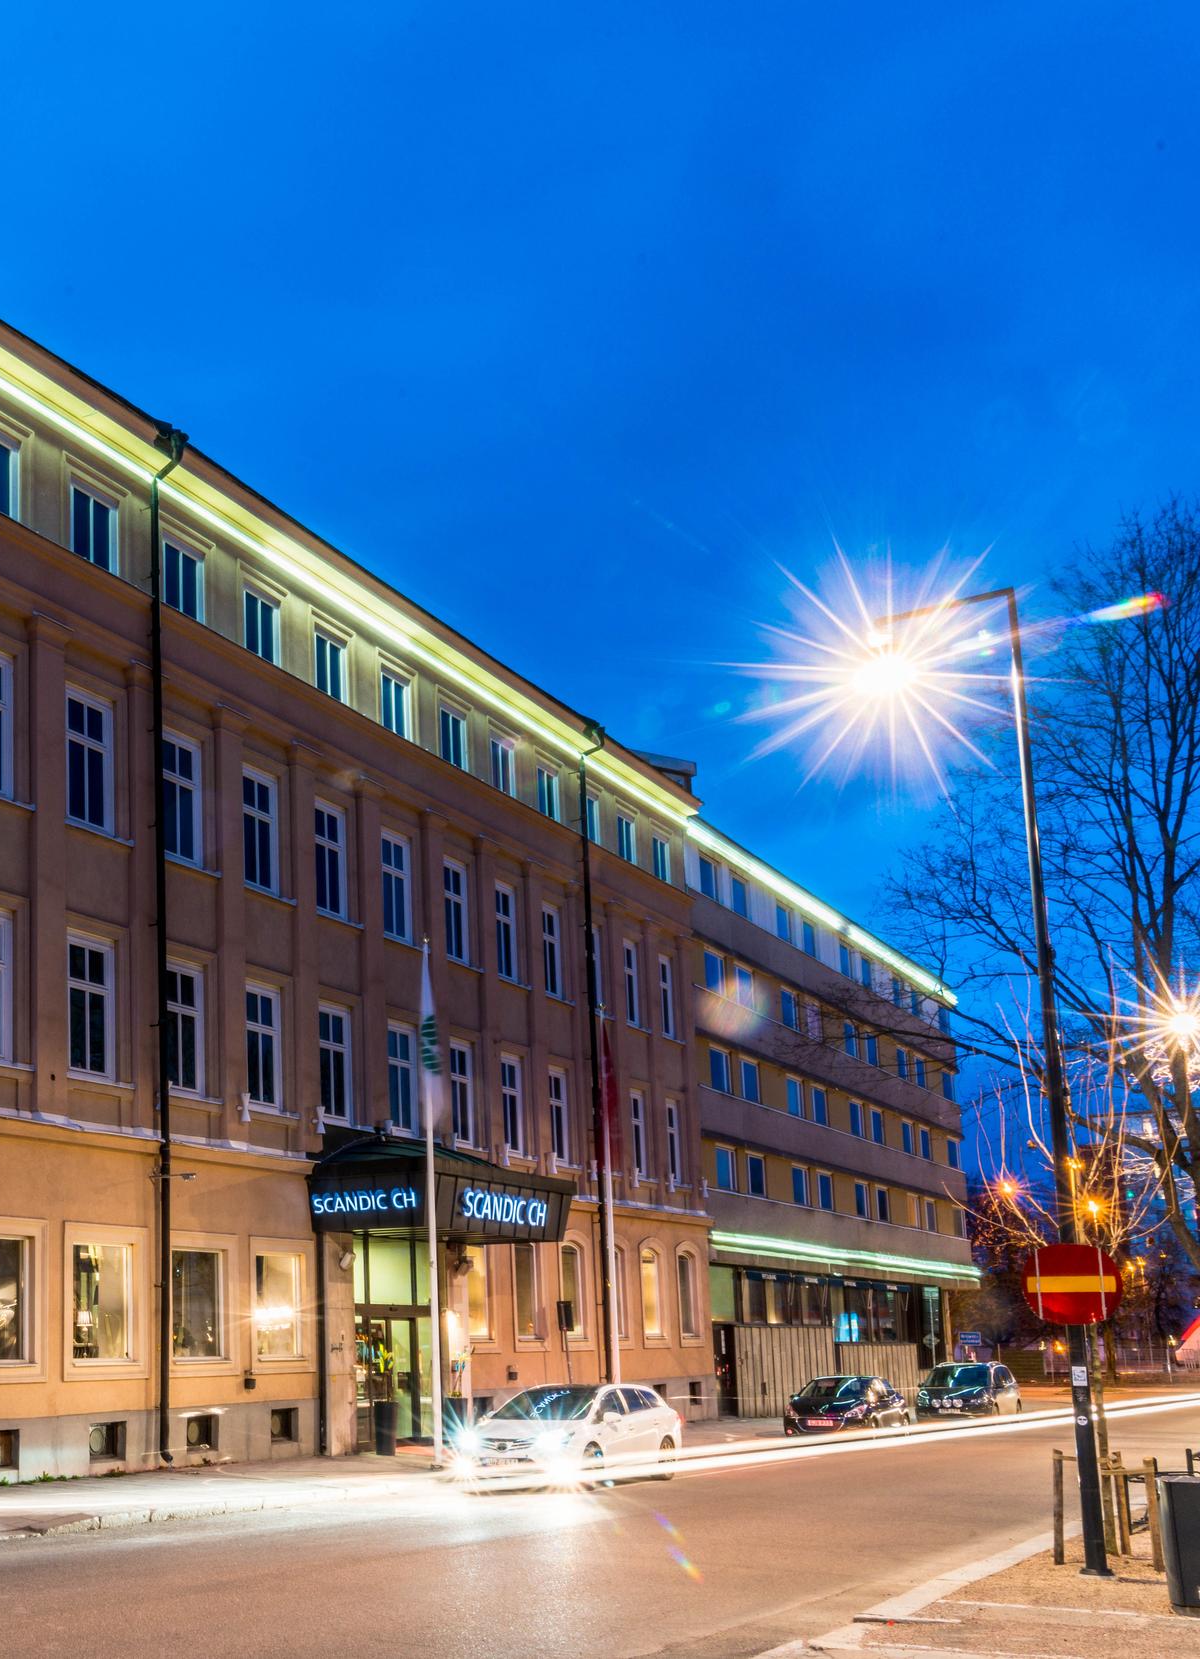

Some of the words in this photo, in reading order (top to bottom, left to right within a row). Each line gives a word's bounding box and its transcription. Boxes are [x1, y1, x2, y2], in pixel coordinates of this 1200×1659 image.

[312, 1193, 388, 1214] SCANDIC
[392, 1191, 416, 1209] CH
[463, 1190, 526, 1225] SCANDIC
[528, 1201, 547, 1227] CH
